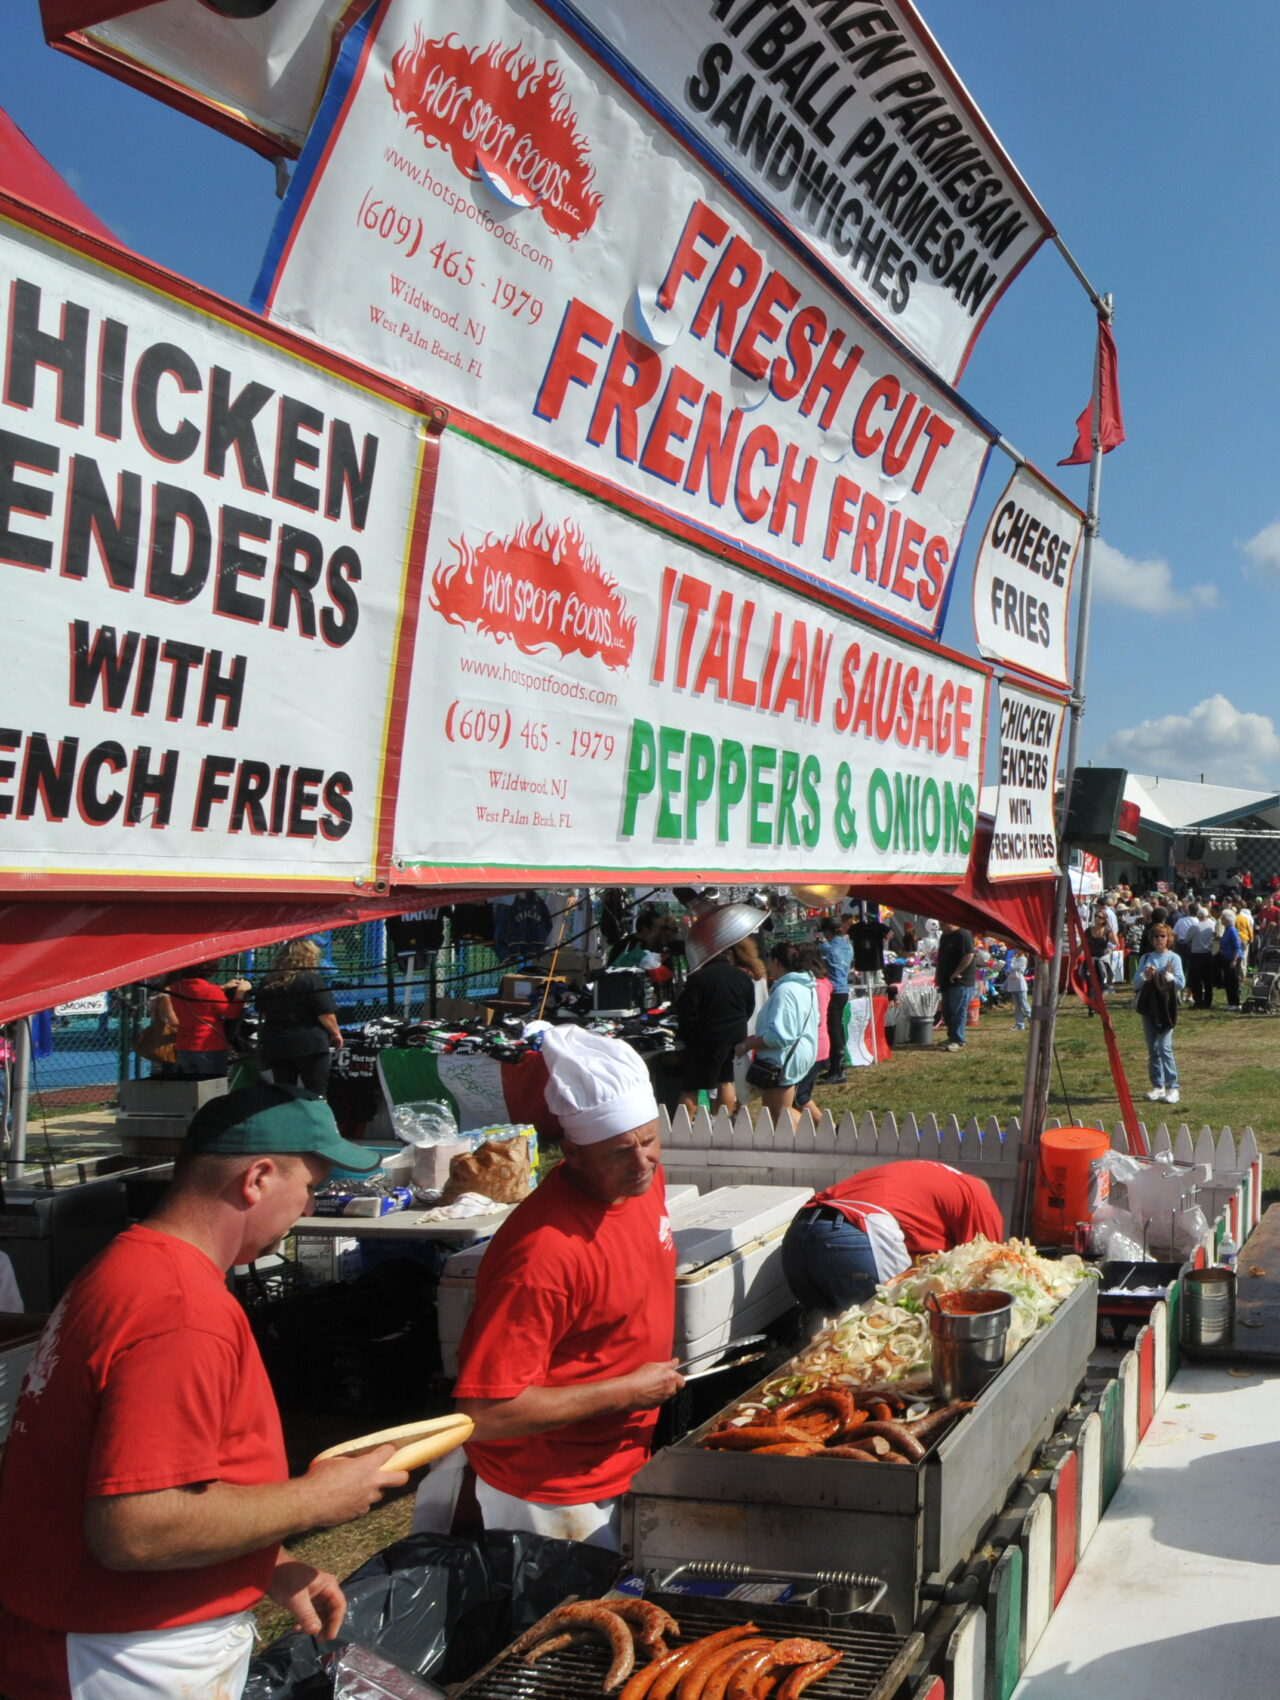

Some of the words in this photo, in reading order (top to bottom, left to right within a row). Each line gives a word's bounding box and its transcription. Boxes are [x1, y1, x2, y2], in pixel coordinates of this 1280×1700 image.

[419, 64, 472, 124] HOT
[462, 98, 515, 162] SPOT
[506, 132, 571, 210] FOODS,
[685, 42, 917, 315] SANDWICHES
[703, 0, 858, 148] TBALL
[839, 116, 998, 318] PARMESAN
[871, 70, 1029, 260] PARMESAN
[383, 145, 554, 273] www.hotspotfoods.com
[356, 185, 424, 259] (609)
[430, 238, 477, 286] 465
[491, 276, 544, 326] 1979
[369, 303, 398, 335] West
[399, 322, 428, 352] Palm
[466, 357, 484, 380] FL
[389, 273, 460, 332] Wildwood,
[464, 318, 487, 346] NJ
[657, 198, 866, 432] FRESH
[852, 373, 955, 495] CUT
[2, 276, 379, 532] HICKEN
[532, 296, 817, 547] FRENCH
[822, 474, 950, 611] FRIES
[0, 428, 362, 649] ENDERS
[990, 499, 1072, 589] CHEESE
[481, 566, 513, 617] HOT
[514, 578, 562, 631] SPOT
[560, 590, 614, 648] FOODS,
[990, 575, 1051, 649] FRIES
[68, 618, 248, 731] WITH
[460, 655, 619, 707] www.hotspotfoods.com
[650, 566, 834, 724] ITALIAN
[832, 641, 974, 759] SAUSAGE
[444, 699, 512, 750] (609)
[520, 715, 549, 753] 465
[570, 727, 616, 762] 1979
[1000, 697, 1056, 749] CHICKEN
[192, 753, 354, 842] FRIES
[475, 804, 500, 823] West
[501, 807, 529, 827] Palm
[559, 813, 573, 829] FL
[550, 778, 568, 801] NJ
[618, 717, 821, 849] PEPPERS
[832, 760, 859, 850] &
[866, 766, 976, 857] ONIONS
[1009, 797, 1032, 825] WITH
[1028, 833, 1055, 860] FRIES
[59, 1000, 102, 1011] SMOKING
